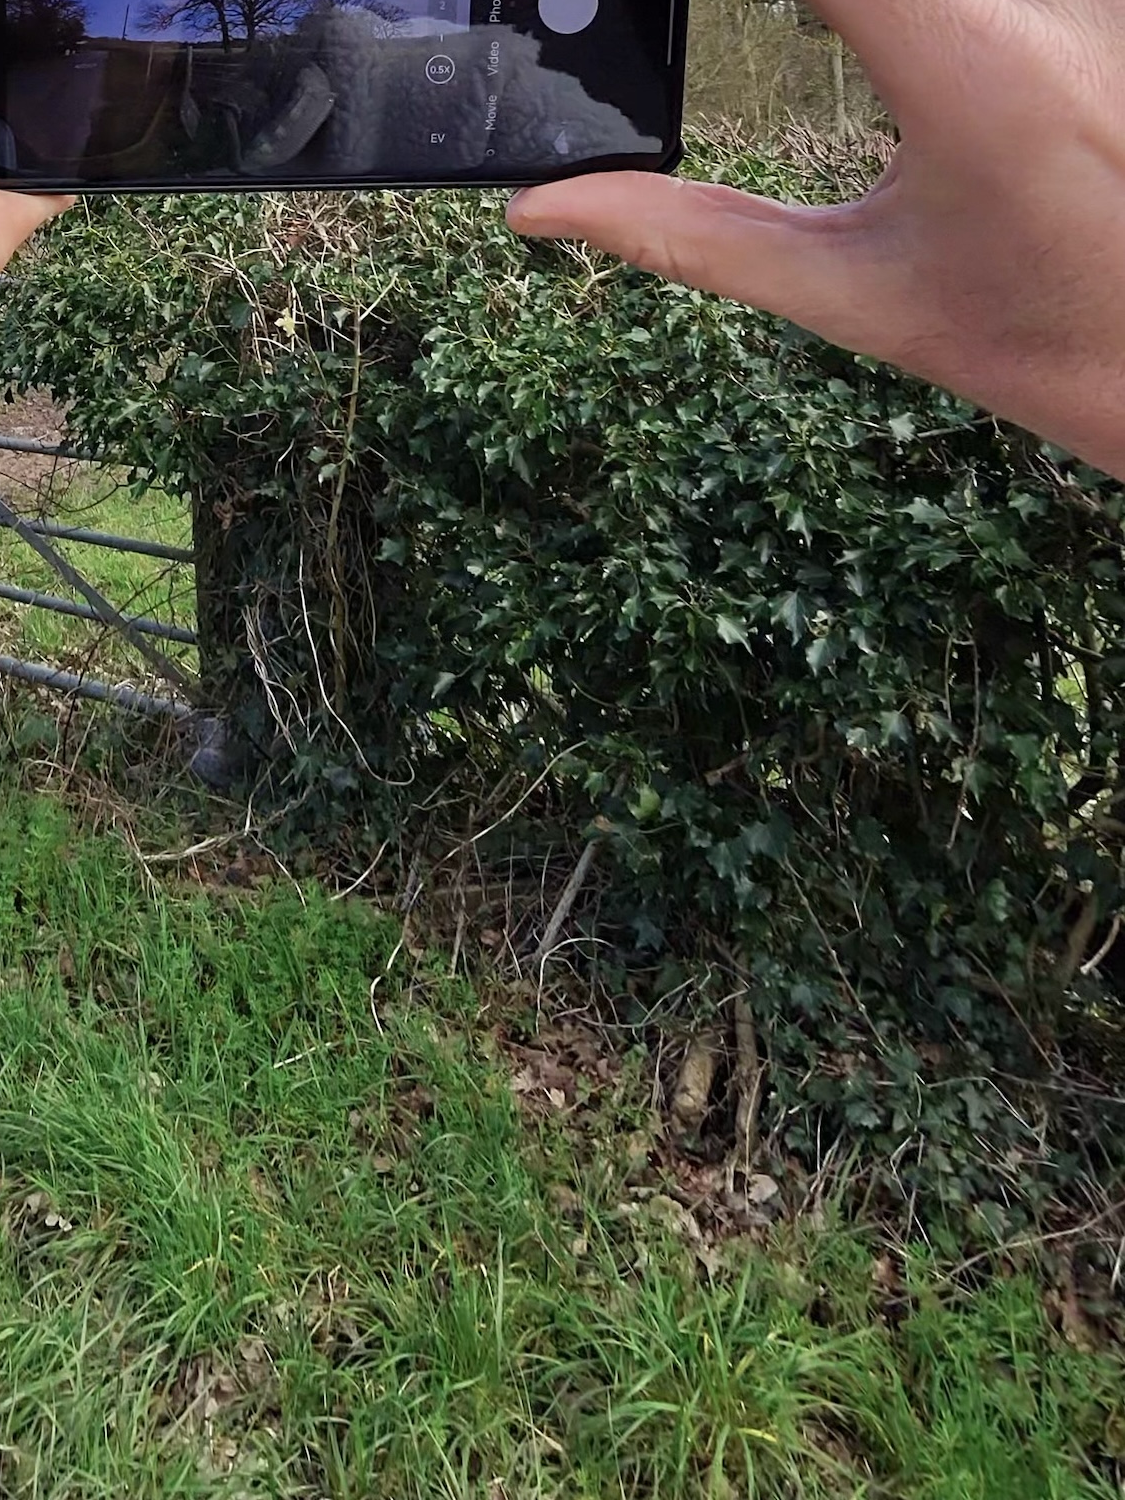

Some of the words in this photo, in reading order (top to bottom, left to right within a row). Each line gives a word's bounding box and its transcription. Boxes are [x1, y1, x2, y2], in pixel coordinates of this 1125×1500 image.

[439, 1, 446, 10] 2
[487, 41, 500, 77] Video
[429, 65, 451, 74] 0.5X
[485, 94, 498, 131] Movie
[430, 133, 446, 143] EV
